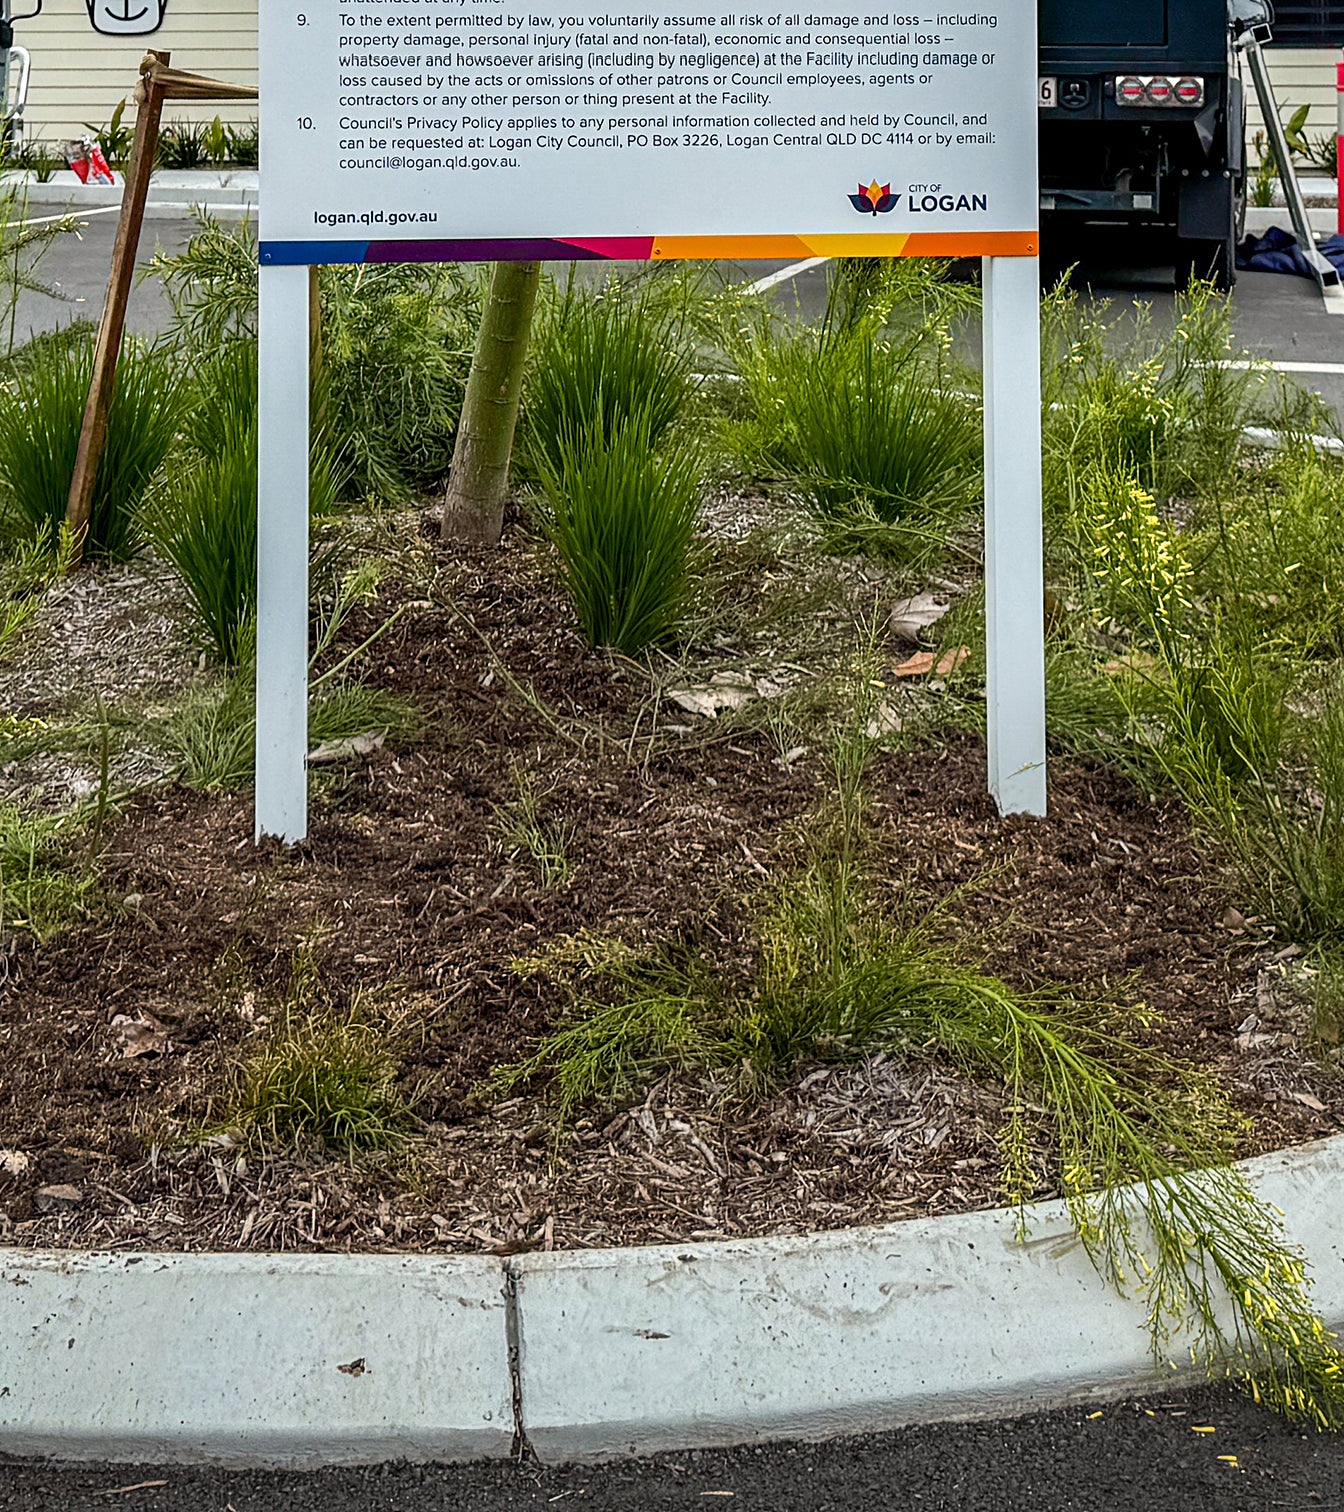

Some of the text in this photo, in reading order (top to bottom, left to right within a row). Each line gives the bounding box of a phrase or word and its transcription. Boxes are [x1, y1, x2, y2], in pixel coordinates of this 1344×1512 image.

[339, 34, 400, 49] property
[403, 33, 465, 49] damage,
[468, 33, 529, 49] personal
[533, 33, 572, 49] injury
[575, 32, 609, 49] (fatal
[612, 32, 639, 46] and
[643, 32, 711, 48] non-fatal),
[714, 32, 782, 46] economic
[785, 32, 811, 45] and
[814, 32, 910, 48] consequential
[914, 32, 941, 45] loss
[338, 91, 772, 109] contractors or any other person or thing present at the Facility.
[339, 131, 996, 152] can be requested at: Logan City Council, PO Box 3226, Logan Central QLD DC 4114 or by email:
[339, 155, 521, 172] council@logan.qld.gov.au.
[908, 183, 942, 193] CITY OF
[908, 194, 987, 213] LOGAN
[314, 210, 438, 227] logan.qld.gov.au
